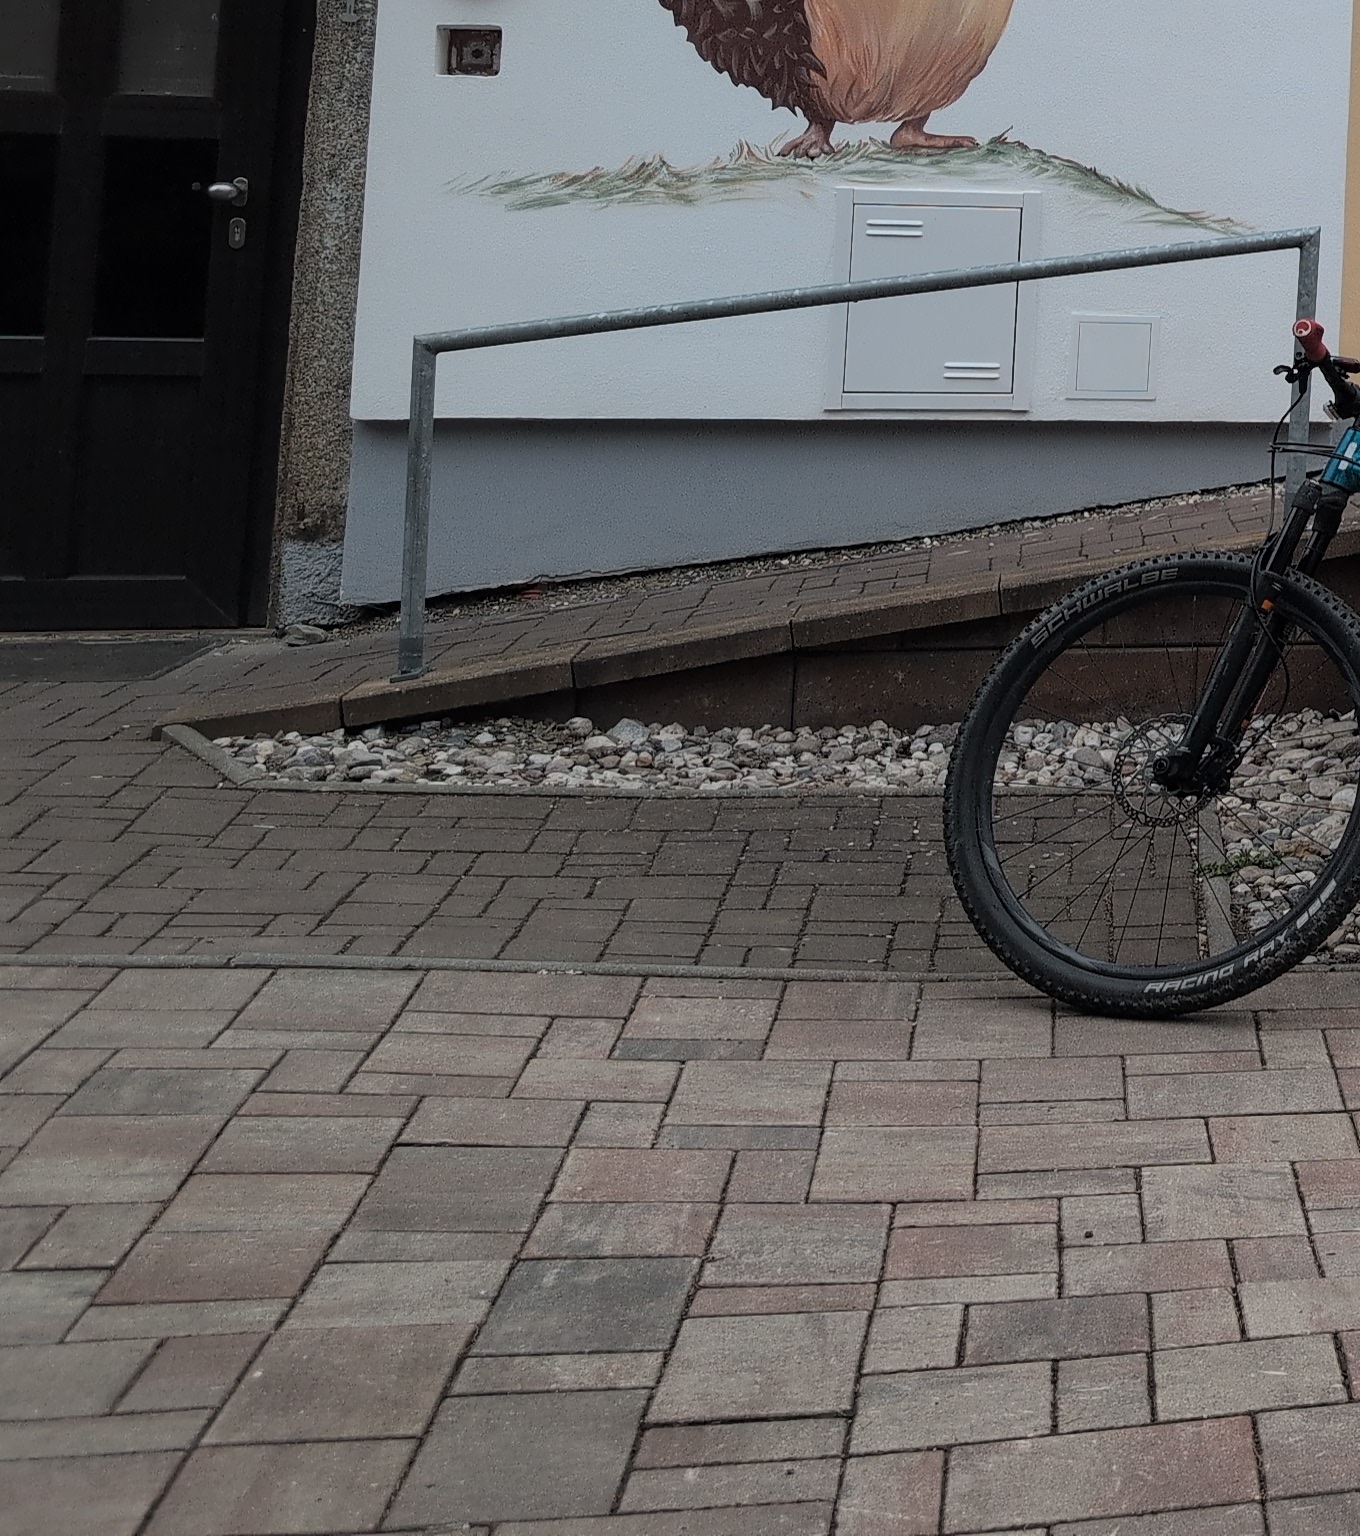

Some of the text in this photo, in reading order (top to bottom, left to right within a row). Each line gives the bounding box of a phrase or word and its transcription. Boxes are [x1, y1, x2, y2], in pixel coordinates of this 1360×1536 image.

[1031, 567, 1179, 649] SCHWALBE
[1143, 928, 1288, 994] RACING RAY
